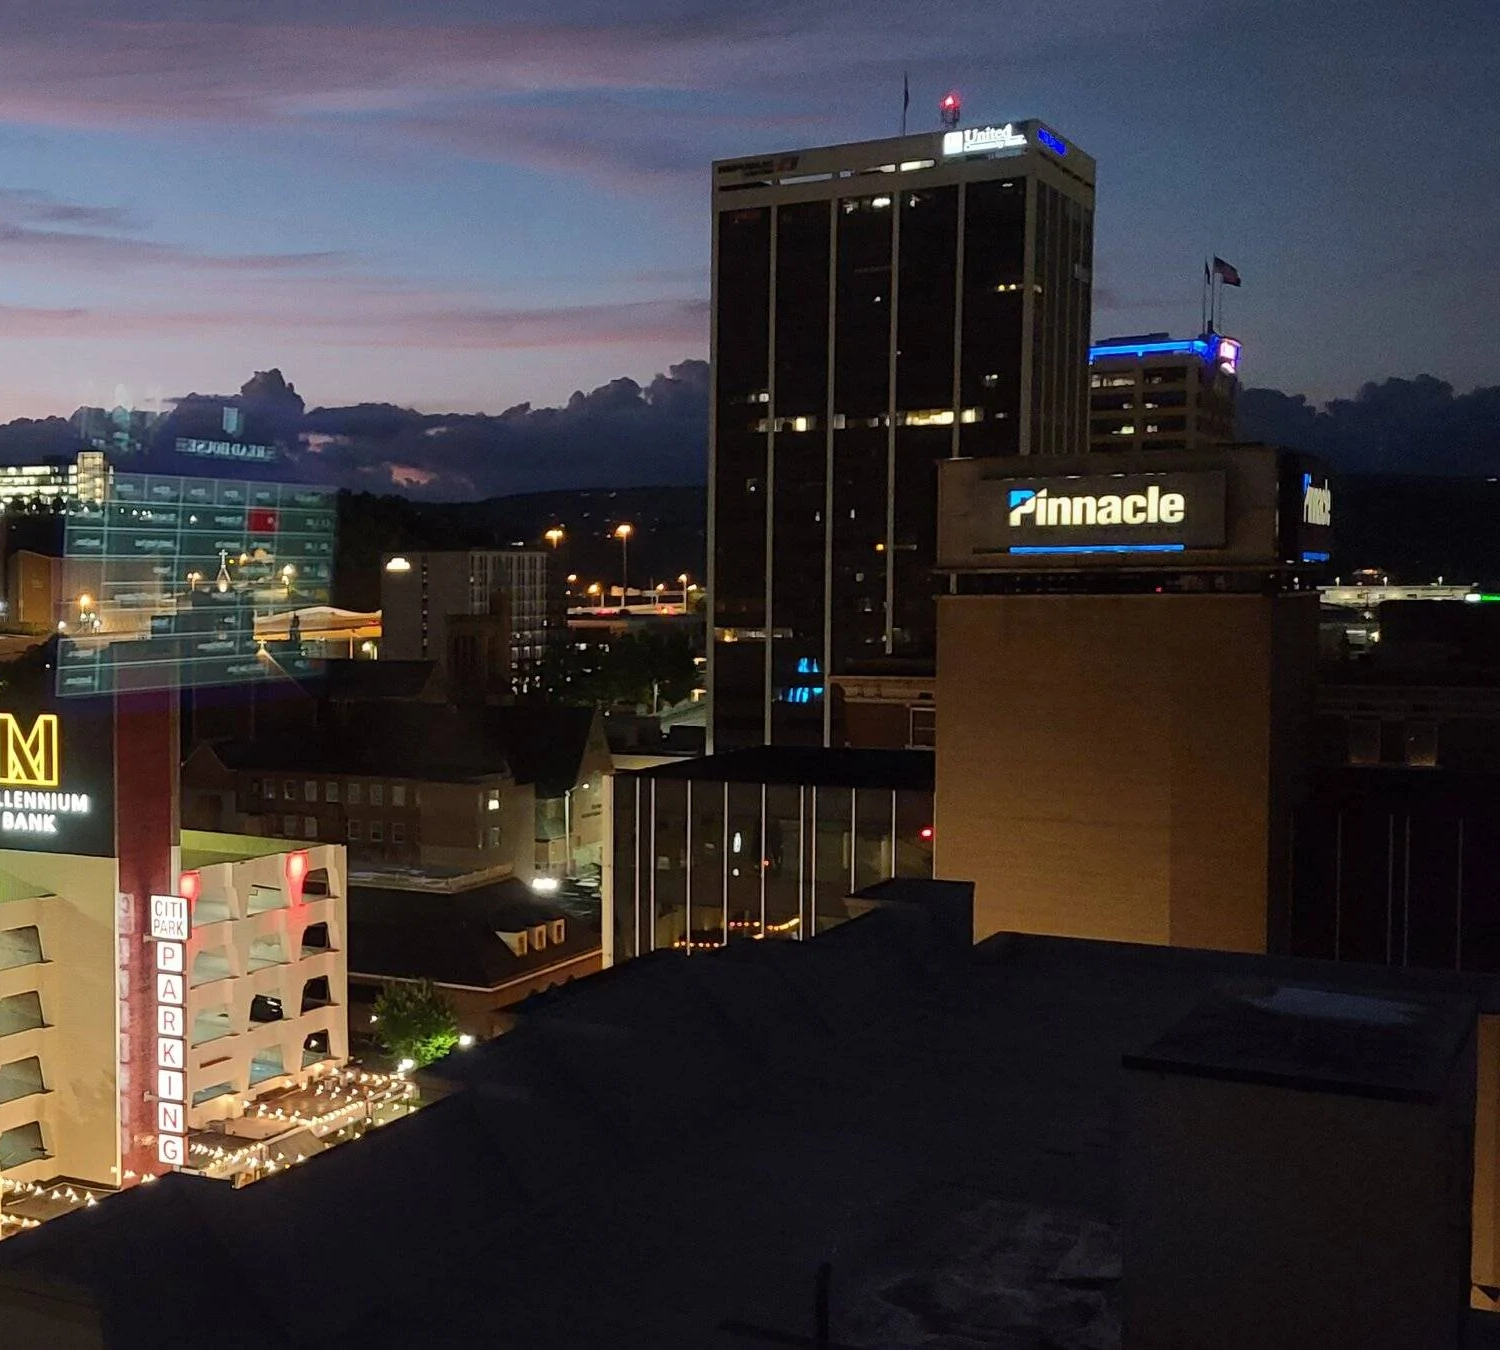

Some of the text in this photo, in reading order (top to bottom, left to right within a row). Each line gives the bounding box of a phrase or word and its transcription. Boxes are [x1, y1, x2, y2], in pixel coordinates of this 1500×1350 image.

[965, 123, 1012, 142] United
[1008, 485, 1186, 527] Pinnacle
[2, 810, 56, 832] BANK
[155, 899, 182, 919] CITI
[153, 918, 183, 936] PARK
[160, 946, 179, 1161] PARKING
